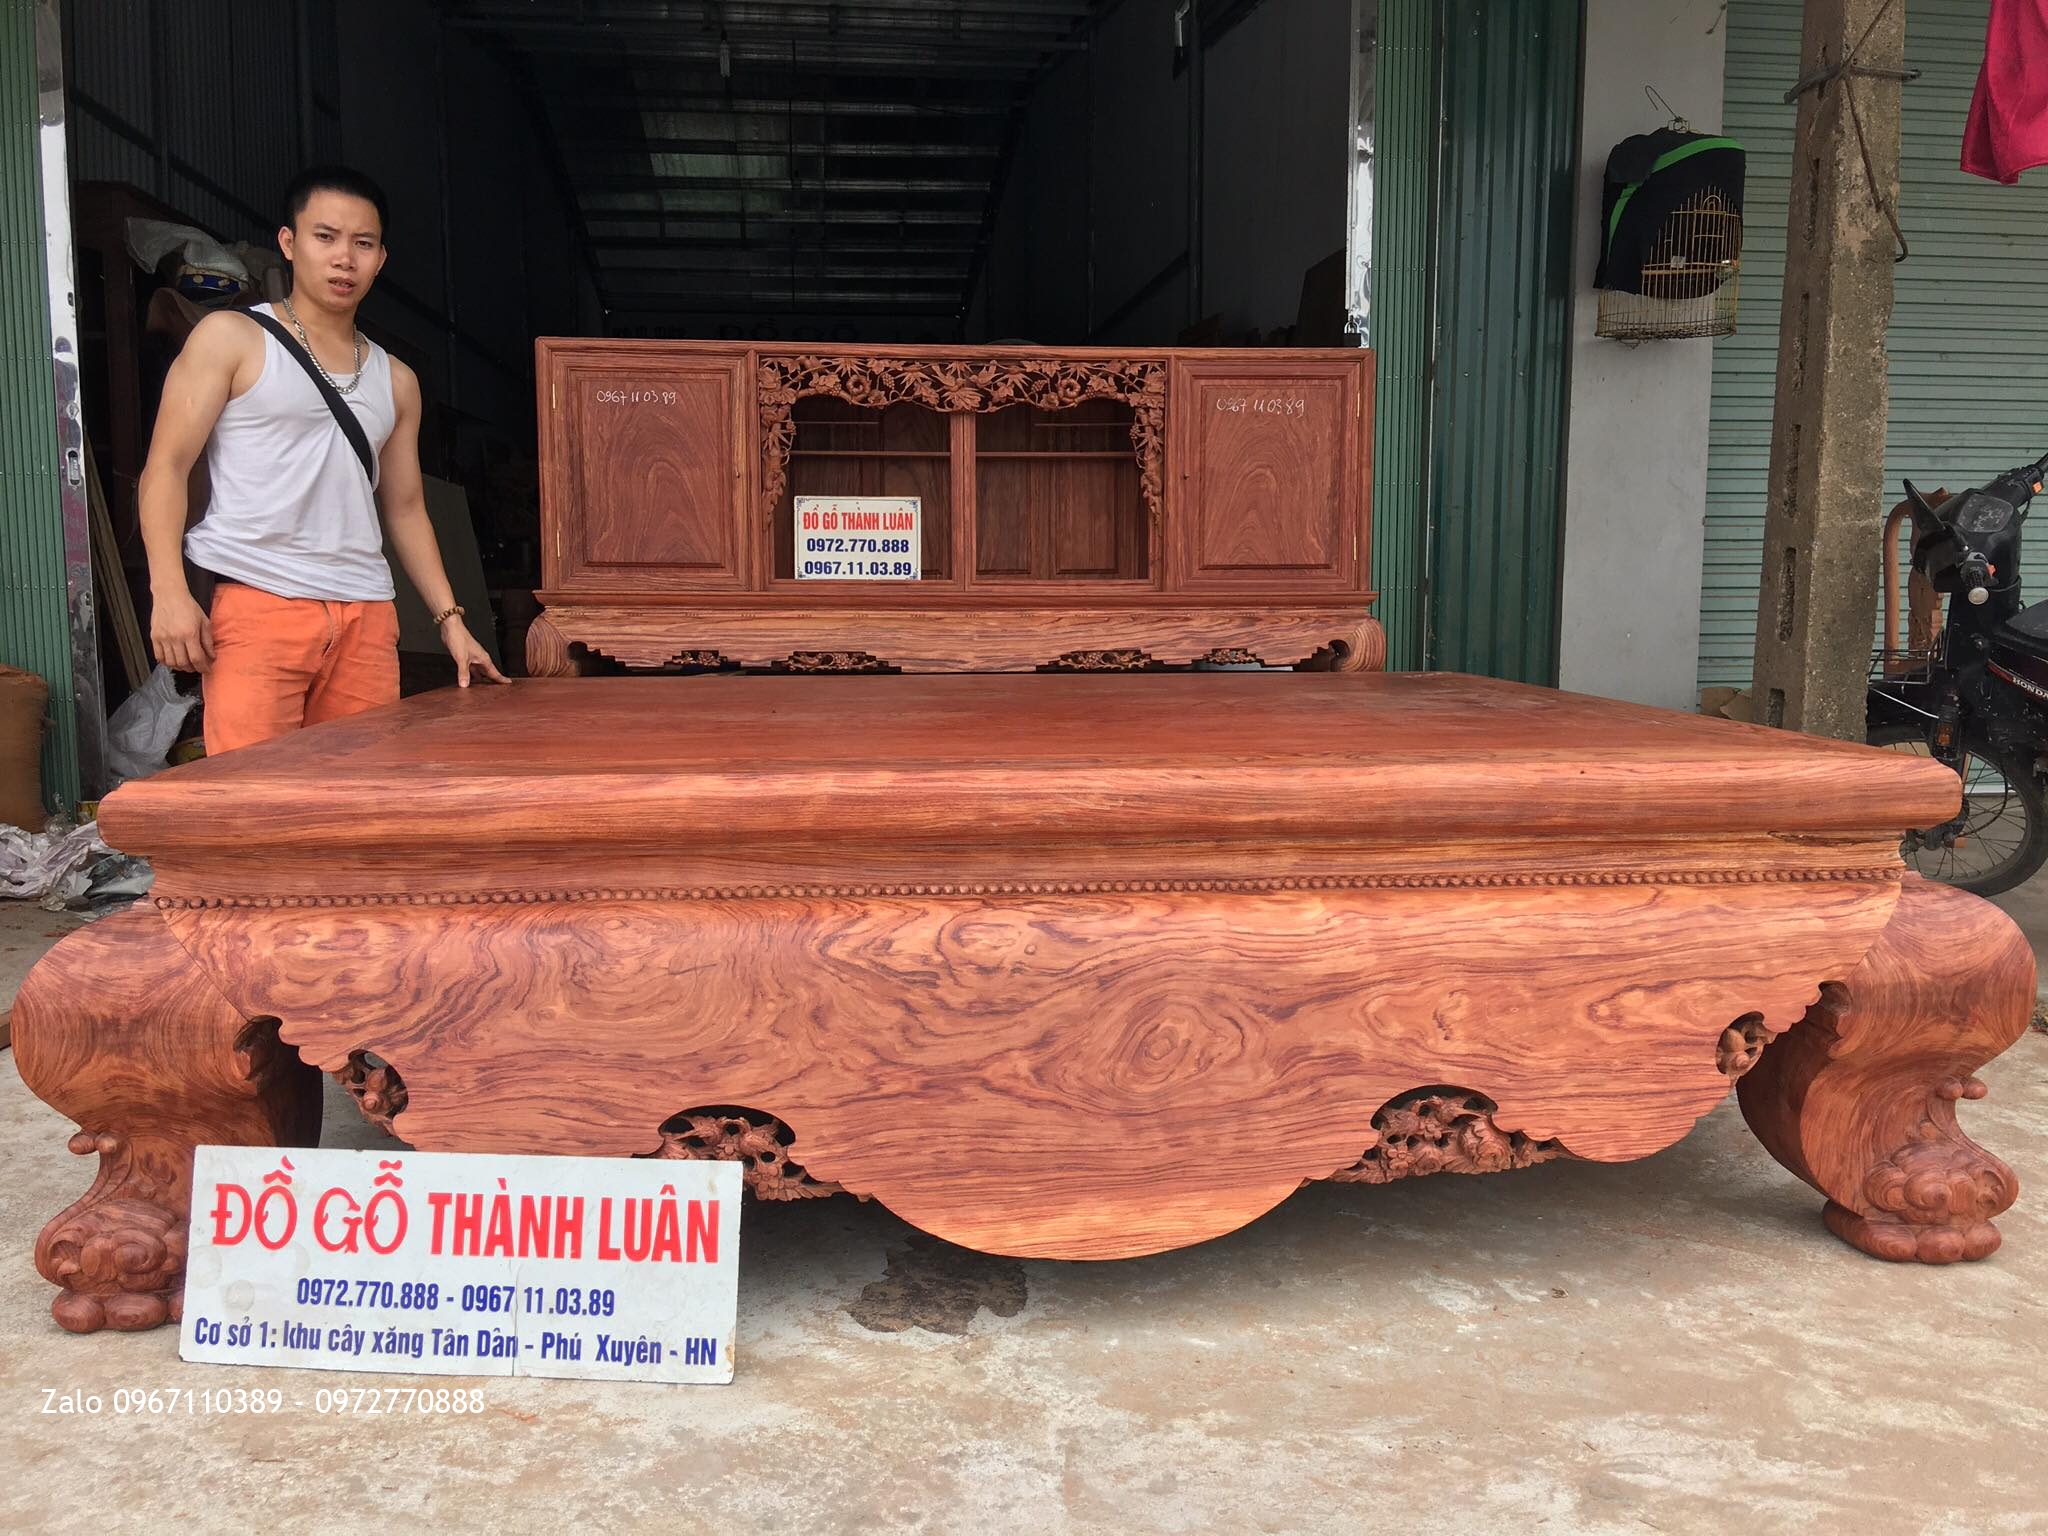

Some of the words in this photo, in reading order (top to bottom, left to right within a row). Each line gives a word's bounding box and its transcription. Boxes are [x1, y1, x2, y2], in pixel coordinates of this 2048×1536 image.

[823, 504, 838, 530] GỖ
[842, 506, 879, 530] THÀNH
[883, 507, 913, 530] LUÂN
[807, 538, 910, 553] 0972.770.888
[804, 561, 912, 576] 0967.11.03.89
[210, 1155, 298, 1250] ĐỒ
[314, 1159, 408, 1255] GỖ
[428, 1177, 584, 1259] THÀNH
[598, 1183, 720, 1263] LUÂN
[296, 1278, 440, 1310] 0972.770.888
[194, 1317, 222, 1345] Cơ
[227, 1316, 252, 1347] sở
[259, 1321, 276, 1348] 1:
[283, 1320, 321, 1350] khu
[328, 1324, 365, 1356] cây
[371, 1326, 424, 1358] xăng
[432, 1328, 469, 1357] Tân
[477, 1327, 519, 1358] Dân
[541, 1332, 582, 1360] Phú
[595, 1333, 662, 1366] Xuyên
[685, 1337, 717, 1365] HN
